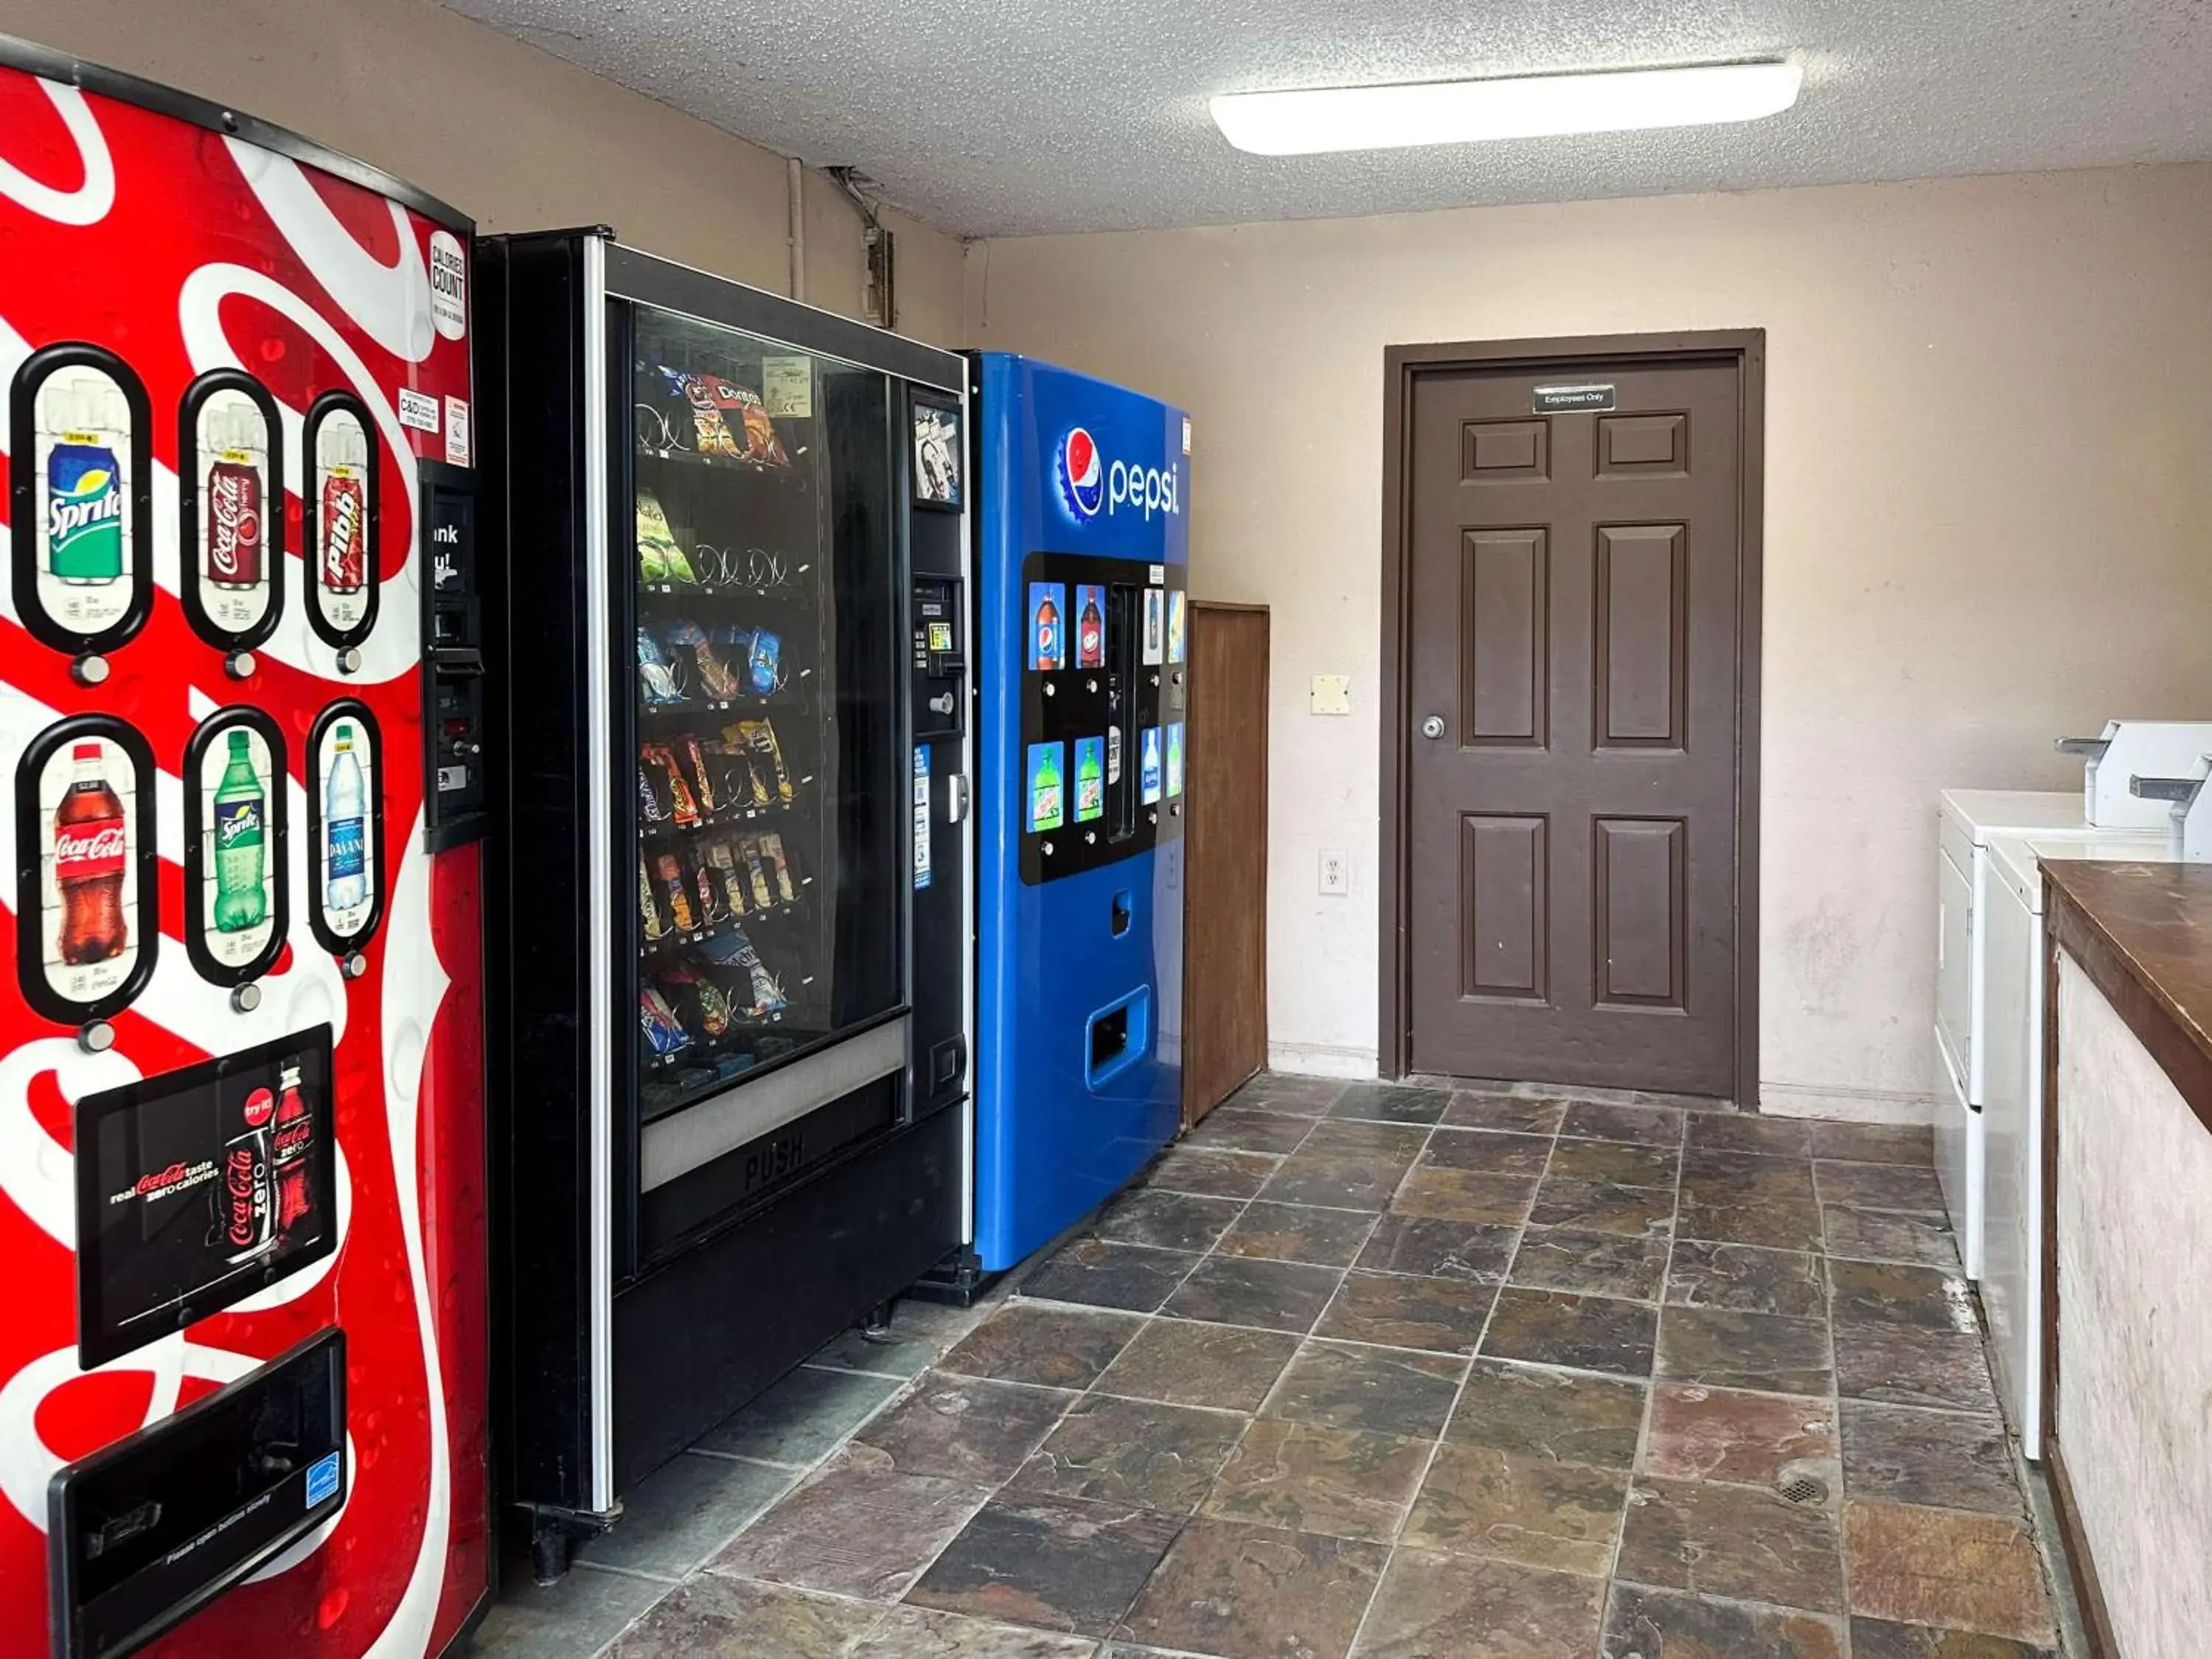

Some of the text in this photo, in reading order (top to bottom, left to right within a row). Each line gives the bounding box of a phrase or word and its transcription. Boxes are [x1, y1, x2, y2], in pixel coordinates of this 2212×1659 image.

[433, 265, 462, 301] COUNT
[717, 385, 762, 406] Doritos
[1545, 393, 1604, 403] Employees Only
[1108, 459, 1178, 522] pepsi
[49, 485, 120, 540] Sprite
[222, 812, 260, 841] Sprite
[281, 1141, 305, 1158] zero
[744, 1132, 804, 1192] PUSH
[111, 1186, 136, 1204] real
[185, 1160, 213, 1178] taste
[147, 1167, 220, 1203] zero calories
[253, 1163, 267, 1217] zero
